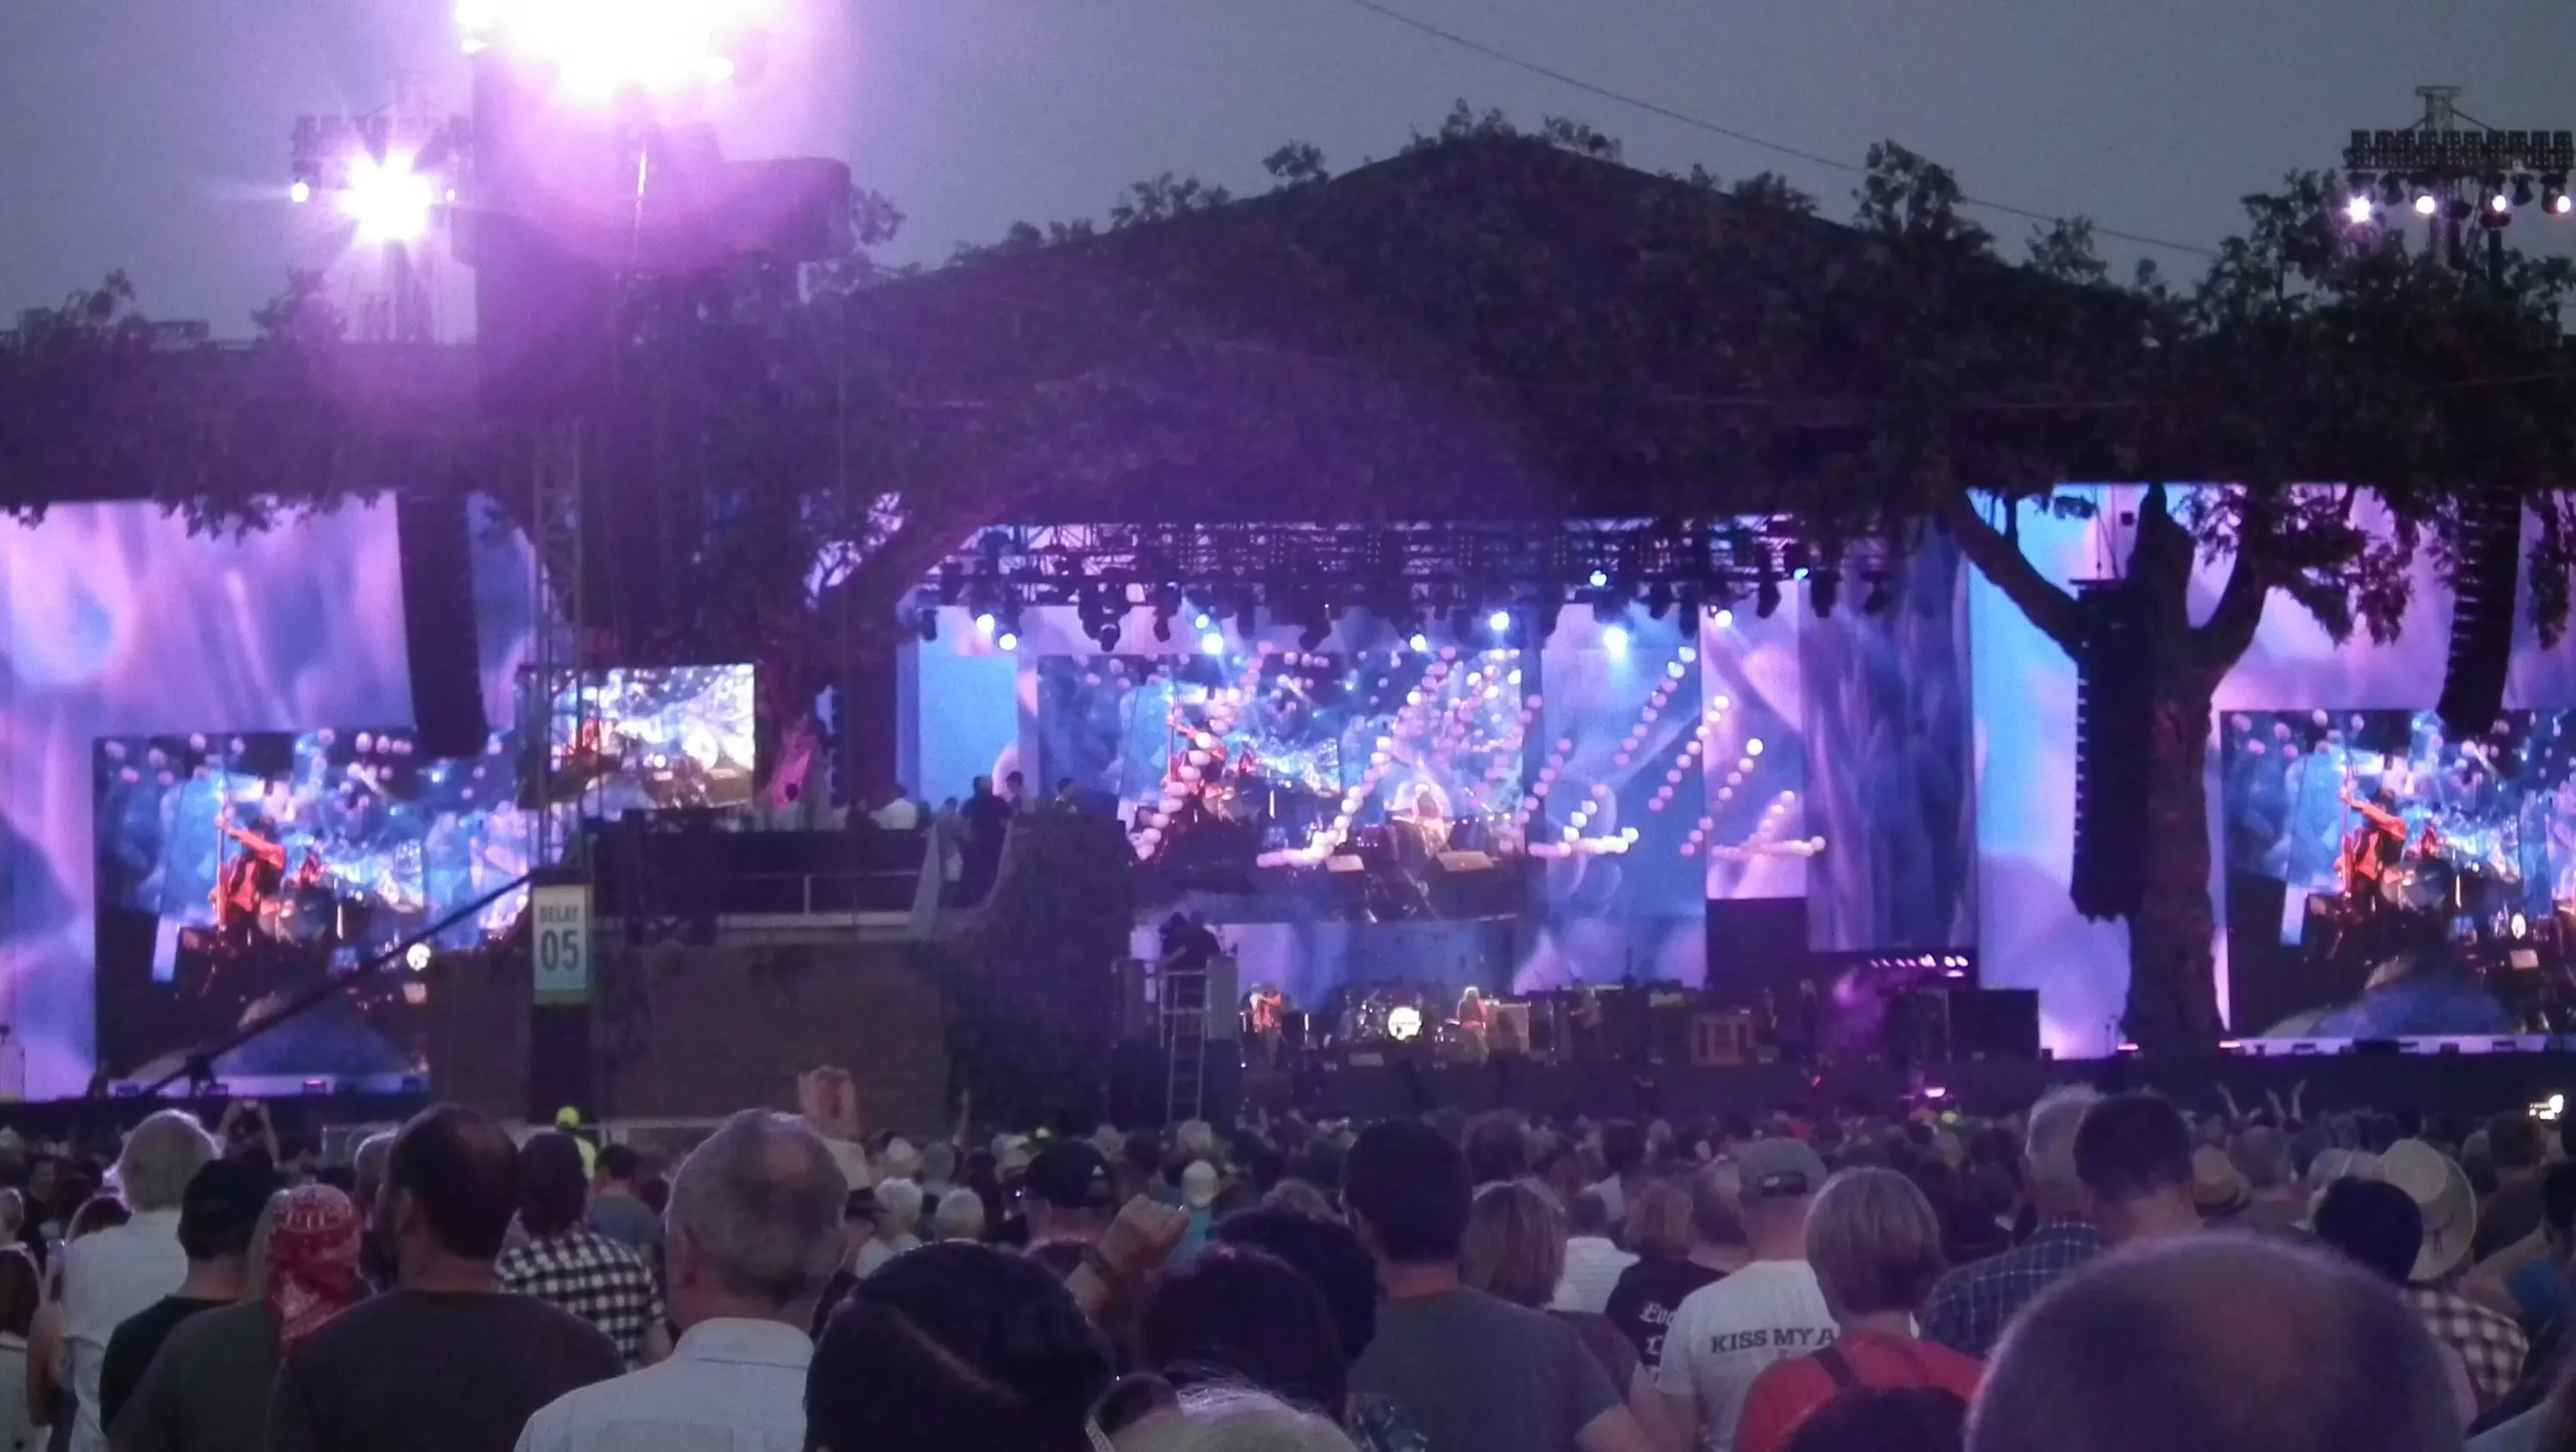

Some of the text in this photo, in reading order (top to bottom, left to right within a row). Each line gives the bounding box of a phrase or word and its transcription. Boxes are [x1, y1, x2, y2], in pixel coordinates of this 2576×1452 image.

[540, 905, 579, 923] DELAY
[540, 928, 580, 970] 05
[1711, 1329, 1767, 1353] KISS
[1772, 1327, 1814, 1346] MY
